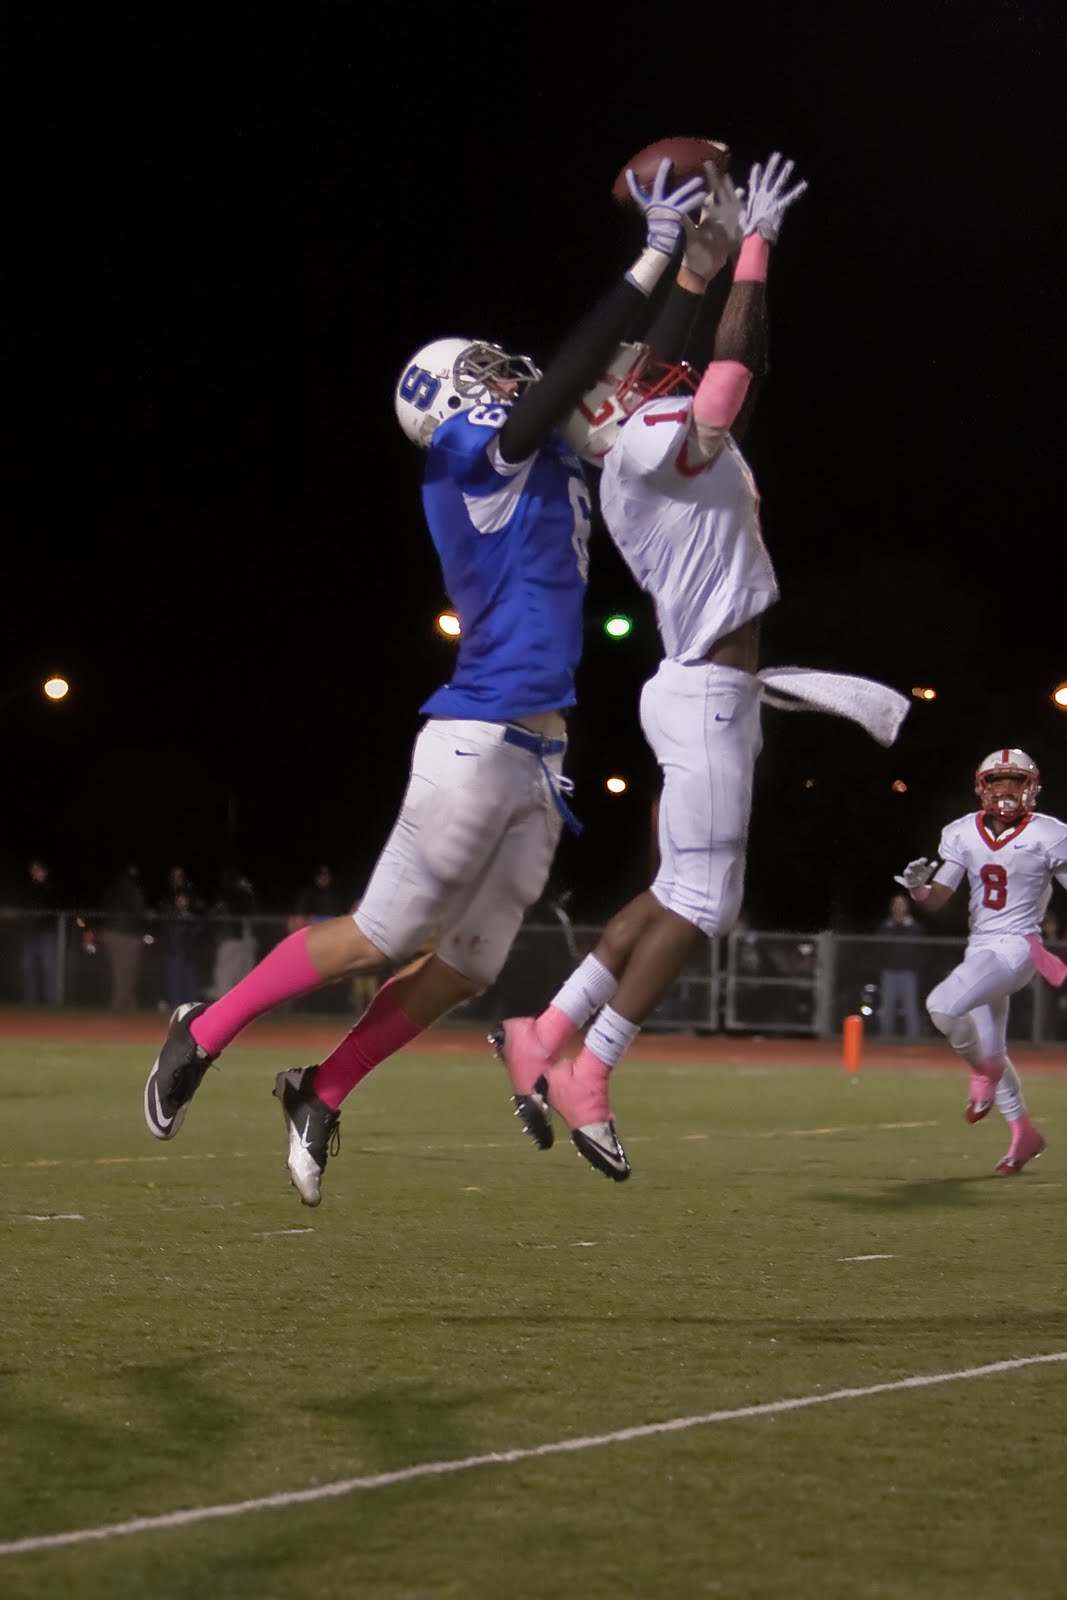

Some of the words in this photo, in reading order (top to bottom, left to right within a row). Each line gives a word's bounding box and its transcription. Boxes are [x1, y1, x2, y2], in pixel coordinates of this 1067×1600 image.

[400, 364, 441, 412] S
[643, 410, 688, 426] 1
[980, 863, 1008, 911] 8
